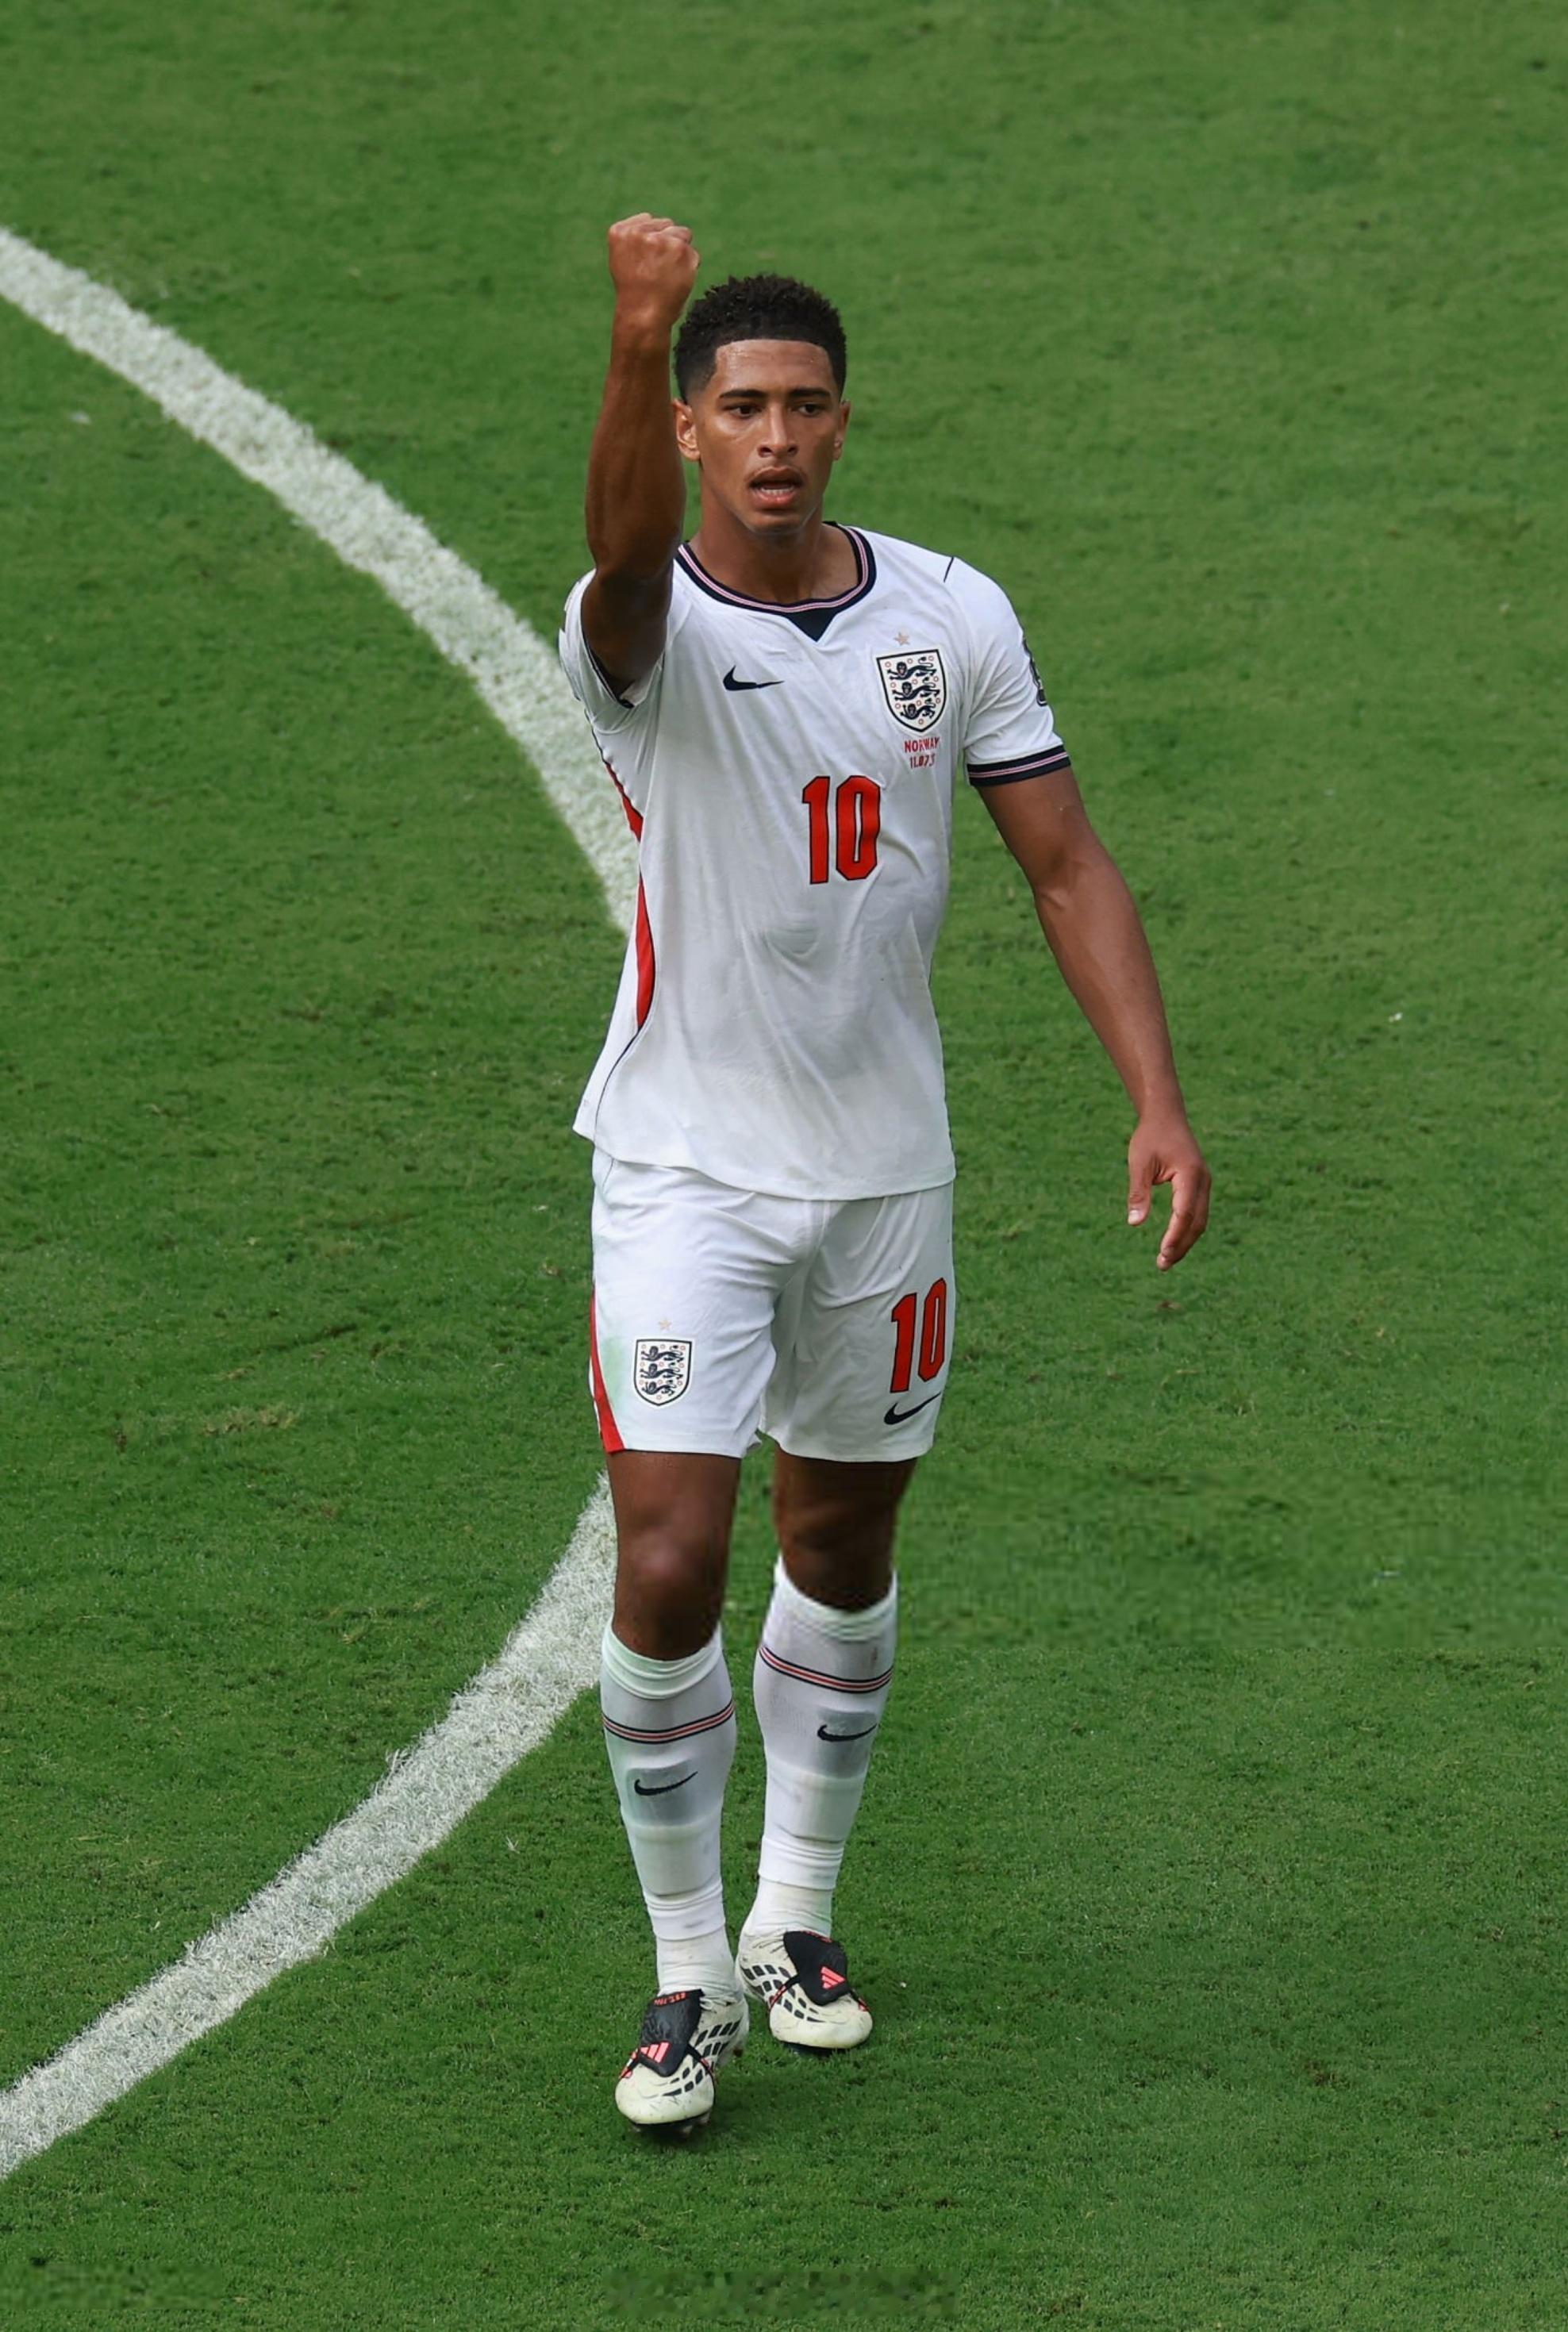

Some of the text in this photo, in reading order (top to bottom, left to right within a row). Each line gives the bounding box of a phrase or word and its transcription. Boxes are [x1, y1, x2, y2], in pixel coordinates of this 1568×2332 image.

[904, 736, 940, 753] NORWAY
[801, 775, 882, 885] 10
[890, 1277, 947, 1393] 10
